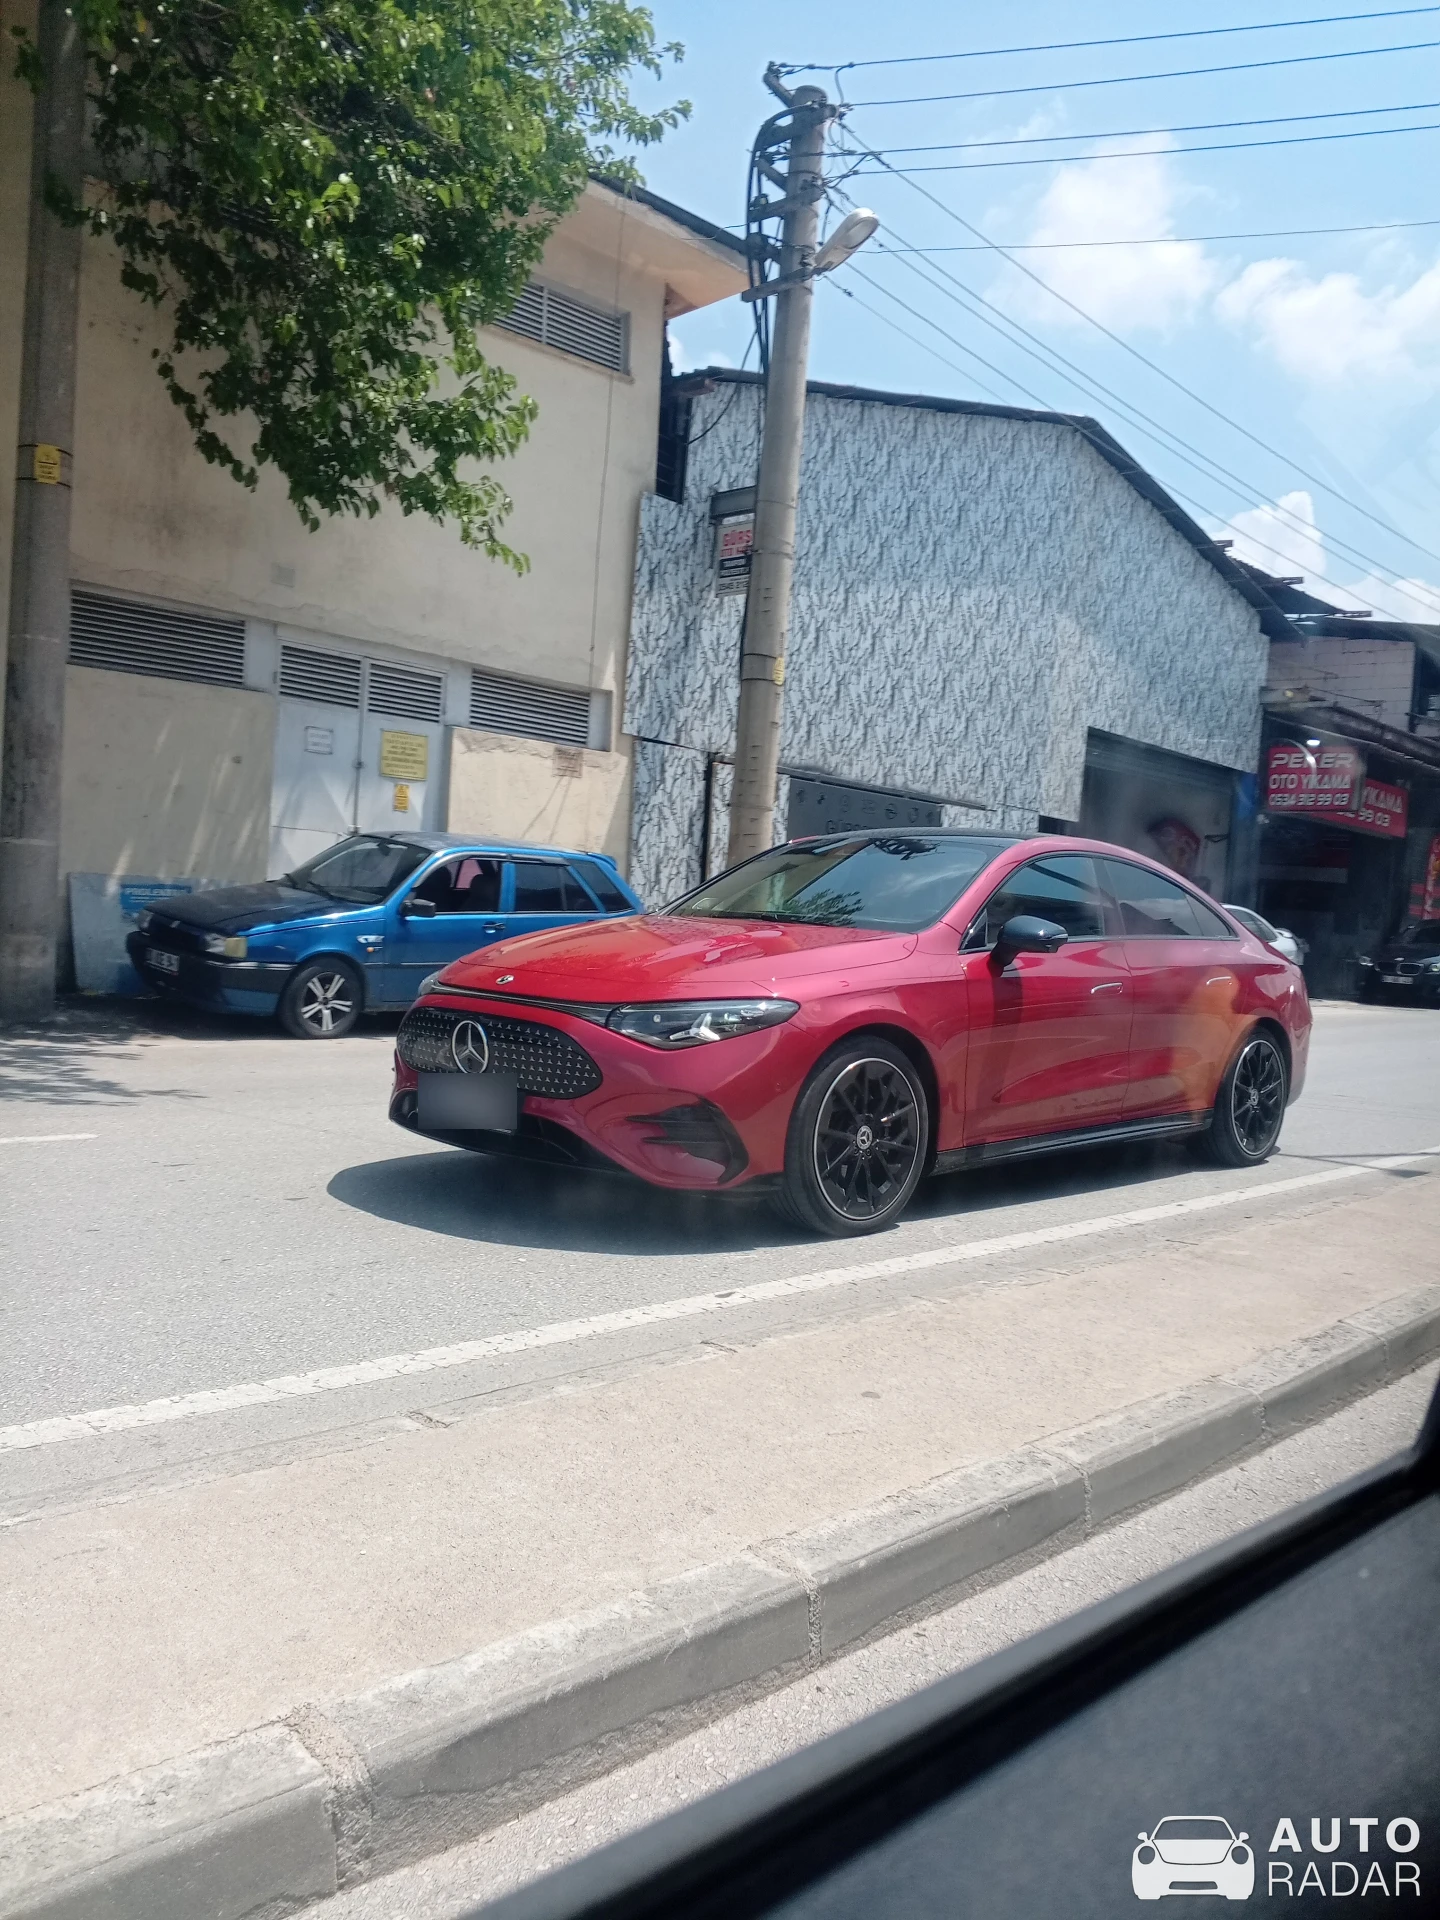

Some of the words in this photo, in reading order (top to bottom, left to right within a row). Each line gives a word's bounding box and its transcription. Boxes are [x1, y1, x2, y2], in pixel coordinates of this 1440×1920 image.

[1270, 753, 1354, 768] PEKER
[1269, 773, 1299, 790] OTO
[1300, 774, 1352, 789] YIKAMA
[1316, 793, 1333, 806] 99
[1332, 793, 1350, 806] 03
